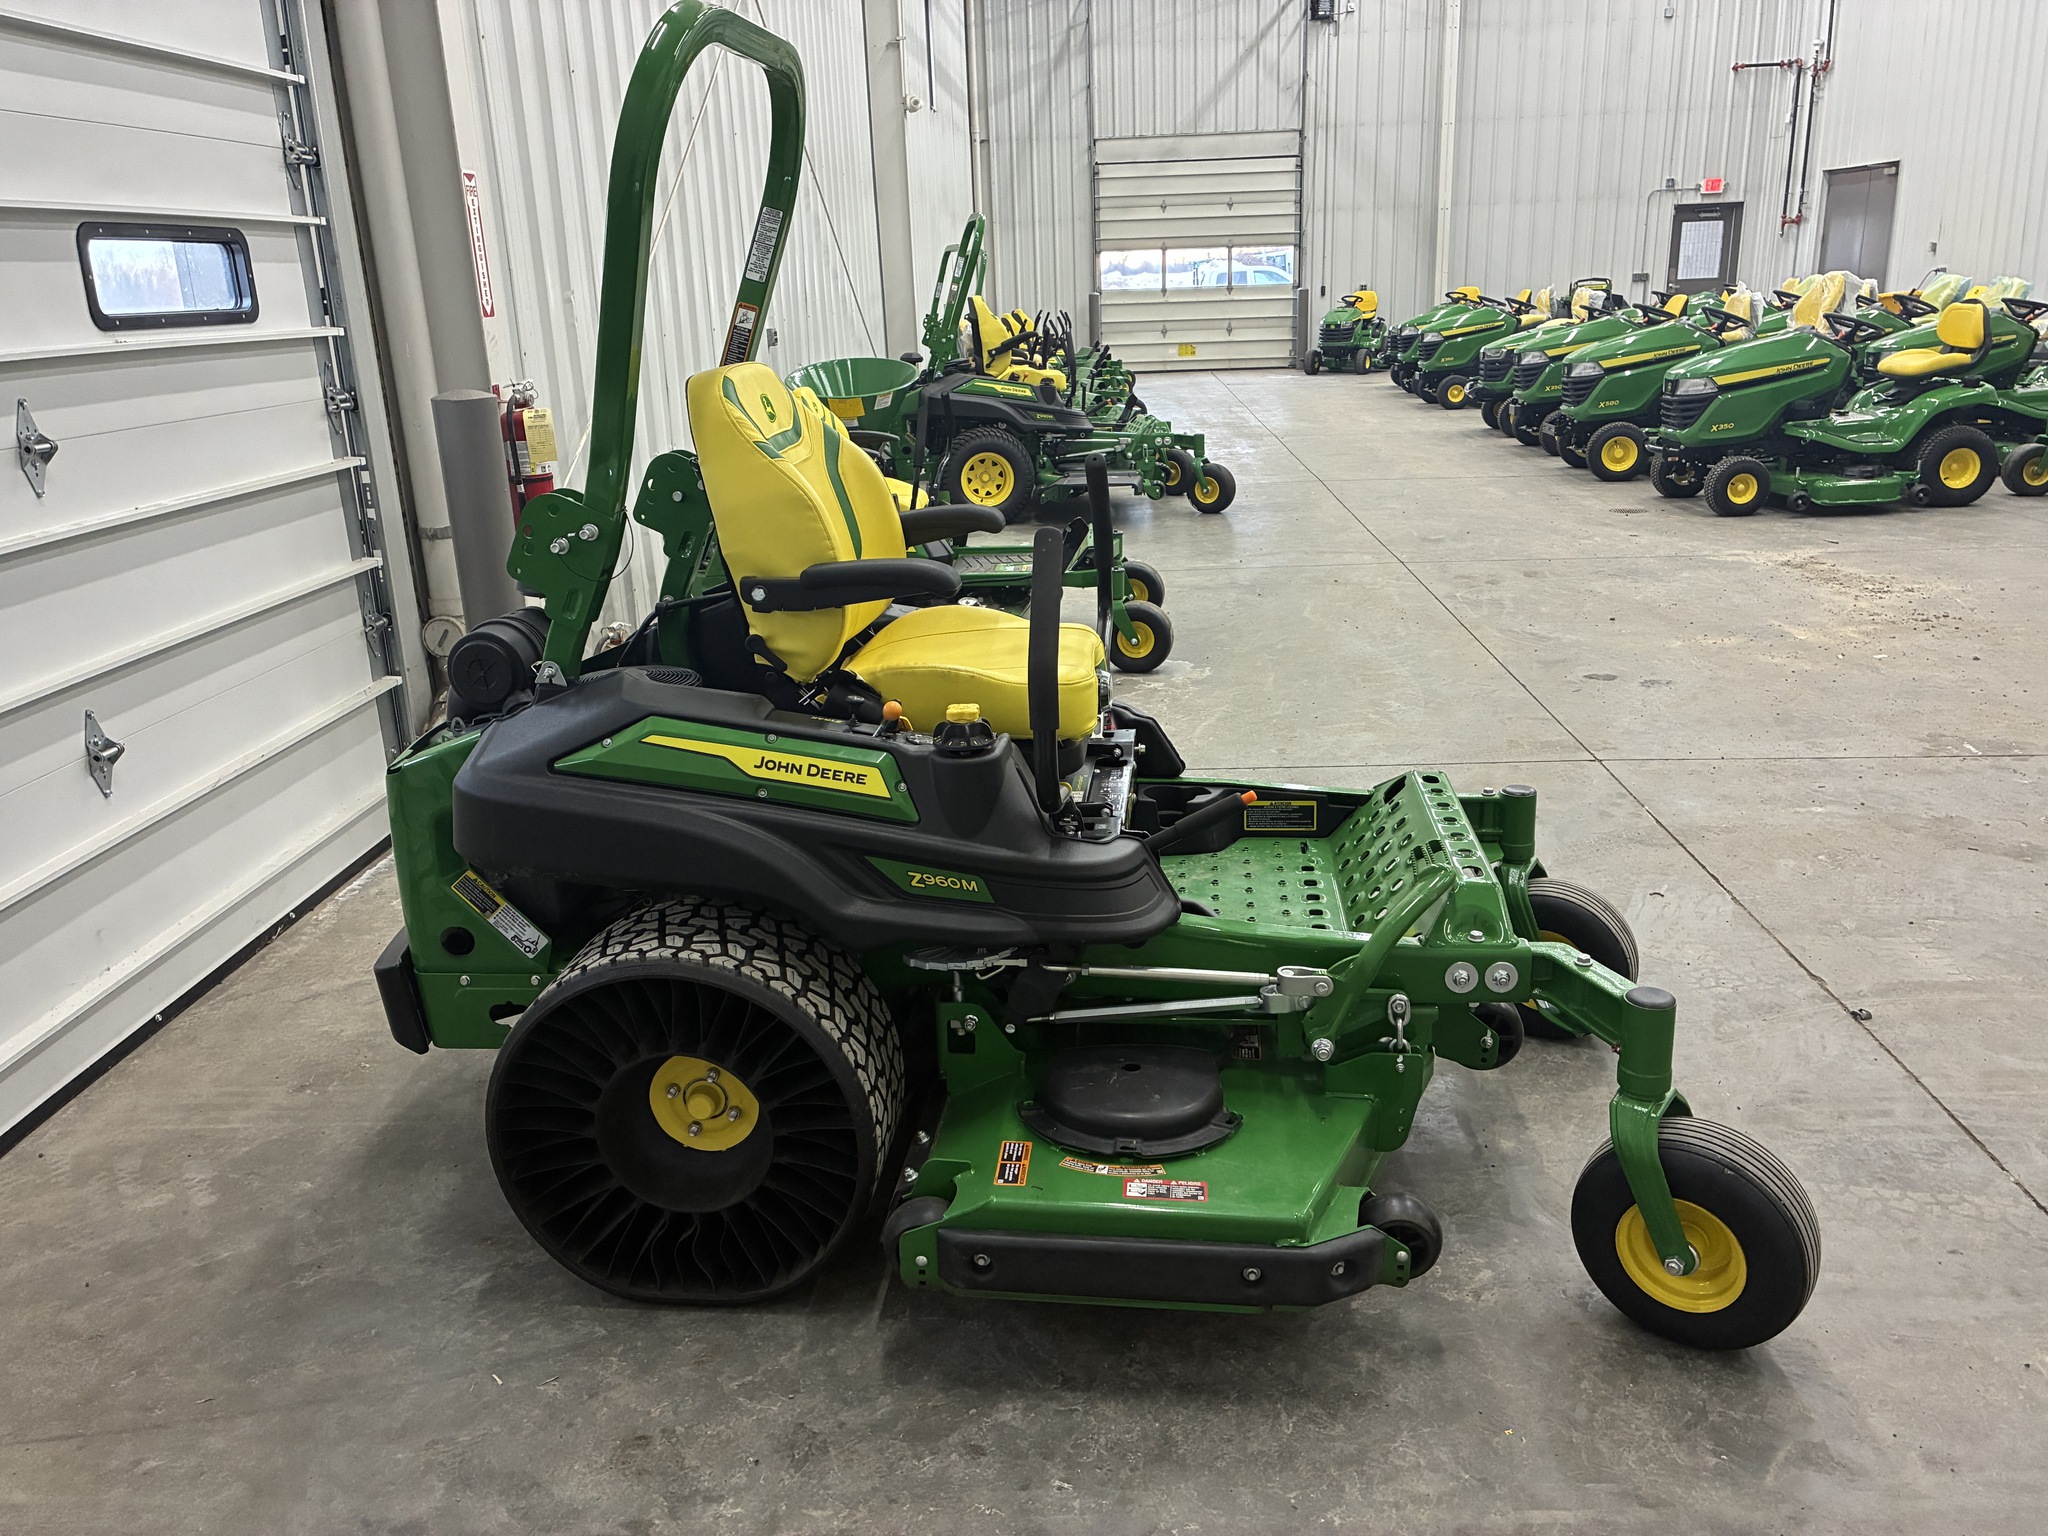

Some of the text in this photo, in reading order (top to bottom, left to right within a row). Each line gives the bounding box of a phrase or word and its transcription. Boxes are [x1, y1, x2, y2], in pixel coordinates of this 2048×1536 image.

[465, 184, 478, 198] FIRE
[1776, 361, 1814, 374] JOHN DEERE
[1710, 422, 1735, 432] X350
[753, 754, 868, 787] JOHN DEERE
[476, 880, 497, 899] CAUTION
[906, 870, 979, 893] Z960M
